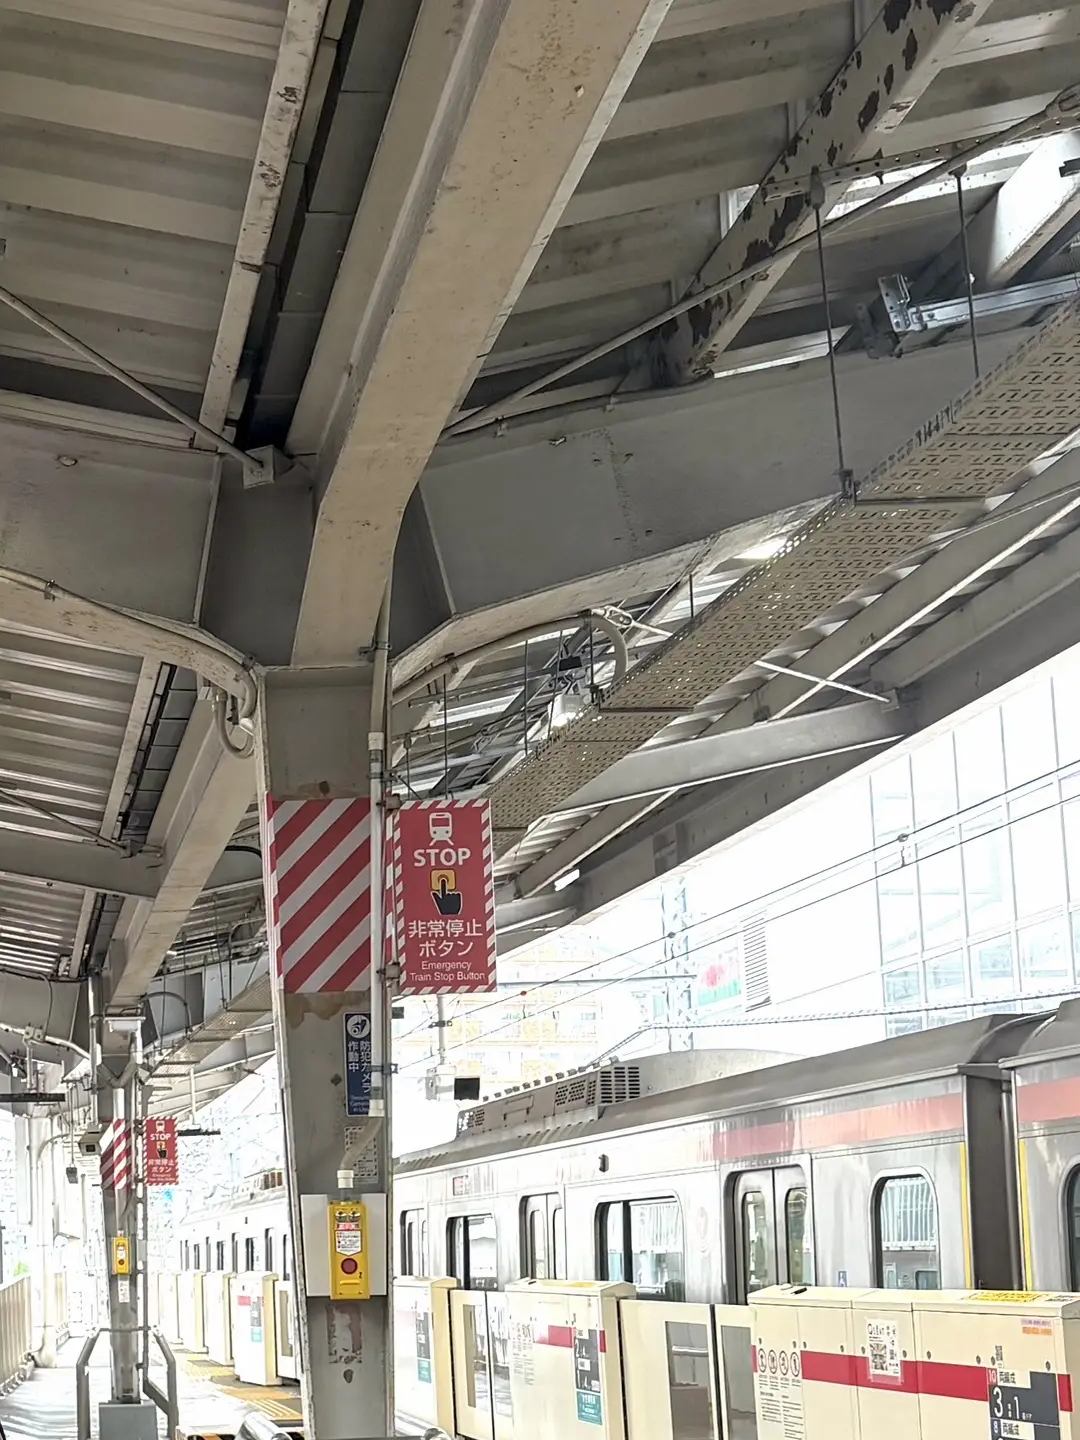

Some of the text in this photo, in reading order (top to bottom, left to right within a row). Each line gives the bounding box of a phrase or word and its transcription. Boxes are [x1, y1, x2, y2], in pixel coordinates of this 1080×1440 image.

[413, 847, 471, 867] STOP
[408, 918, 483, 938] 非常停止
[419, 940, 474, 957] ボタン
[421, 960, 472, 971] Emergency
[410, 970, 486, 983] Train Stop Button
[348, 1041, 359, 1072] 作動中
[988, 1369, 997, 1382] 10
[993, 1386, 1003, 1418] 3
